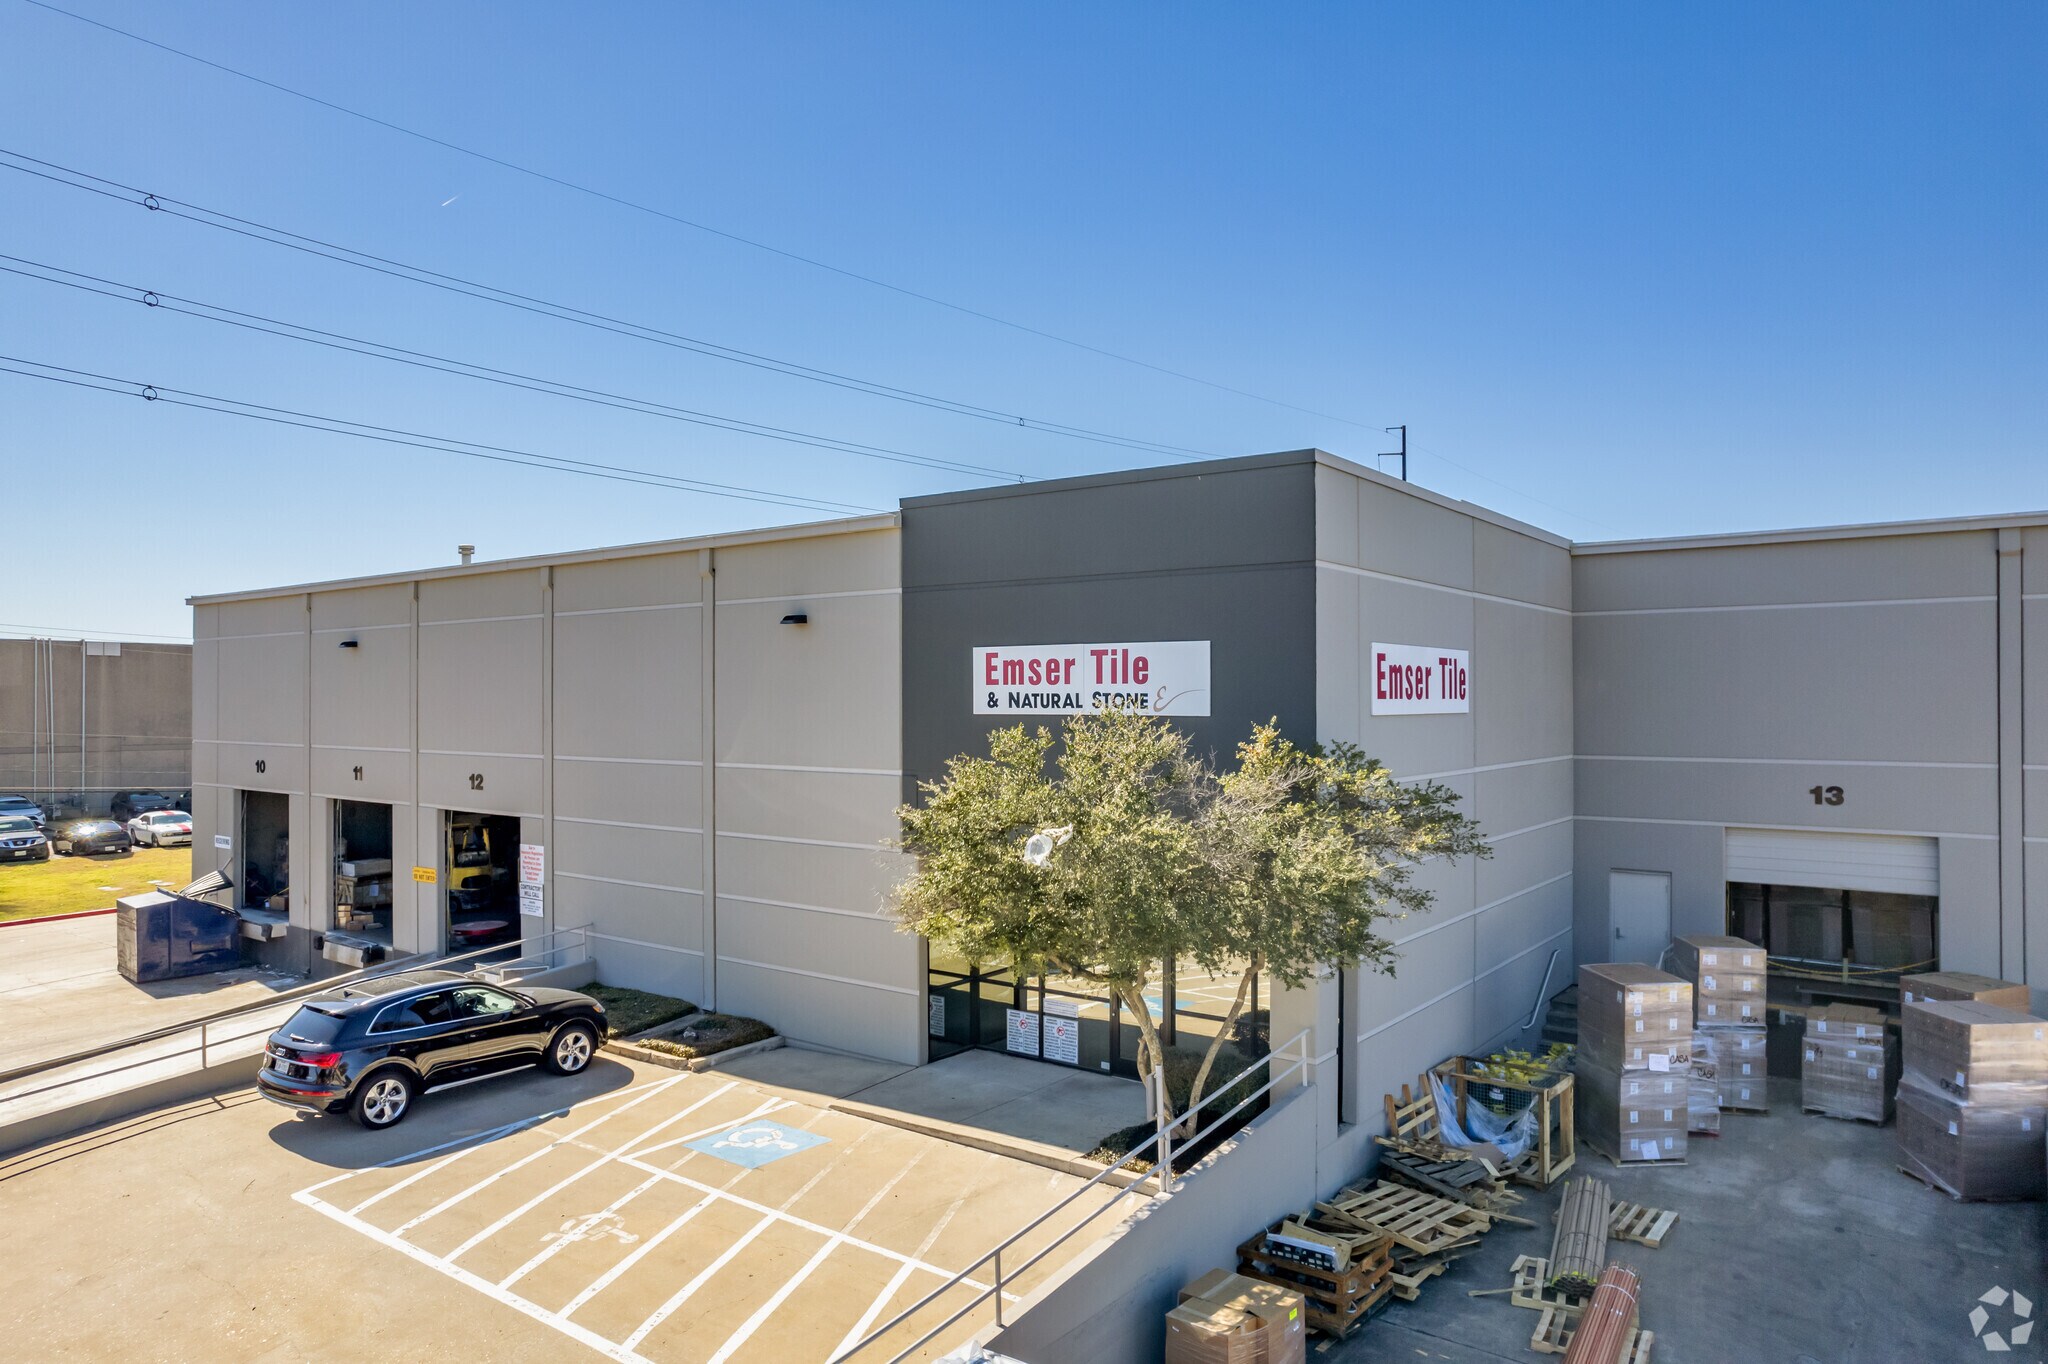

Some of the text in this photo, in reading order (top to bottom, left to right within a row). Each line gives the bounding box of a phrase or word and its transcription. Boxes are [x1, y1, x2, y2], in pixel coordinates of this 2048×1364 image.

[985, 648, 1149, 686] Emser Tile
[1377, 652, 1466, 700] Emser Tile
[987, 691, 1149, 710] & NATURAL STONE
[255, 760, 266, 773] 10
[353, 766, 363, 781] 11
[469, 773, 484, 790] 12
[1809, 785, 1845, 806] 13
